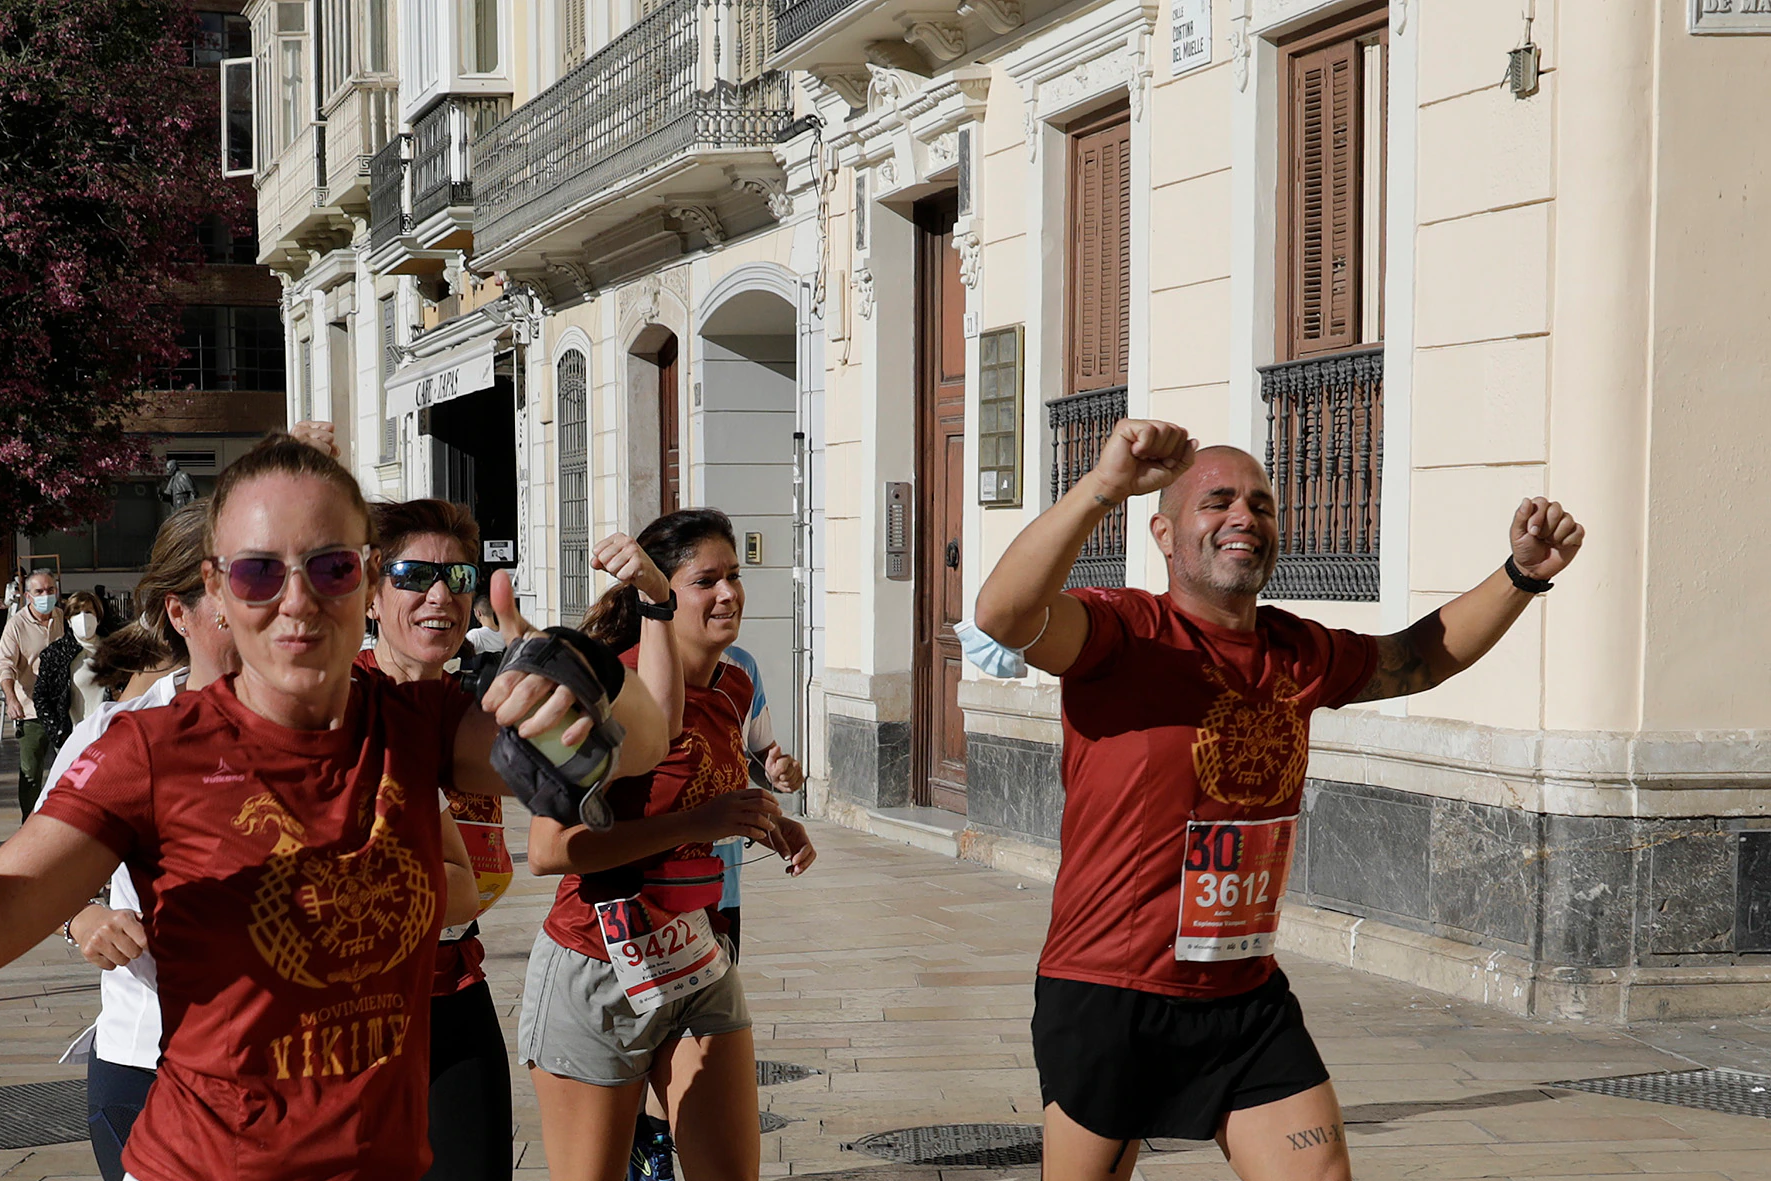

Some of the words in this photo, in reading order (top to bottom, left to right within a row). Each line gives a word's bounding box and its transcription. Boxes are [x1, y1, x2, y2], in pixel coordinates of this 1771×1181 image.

[1195, 870, 1270, 908] 3612
[621, 918, 699, 967] 9422
[299, 993, 404, 1028] MOVIMIENTO
